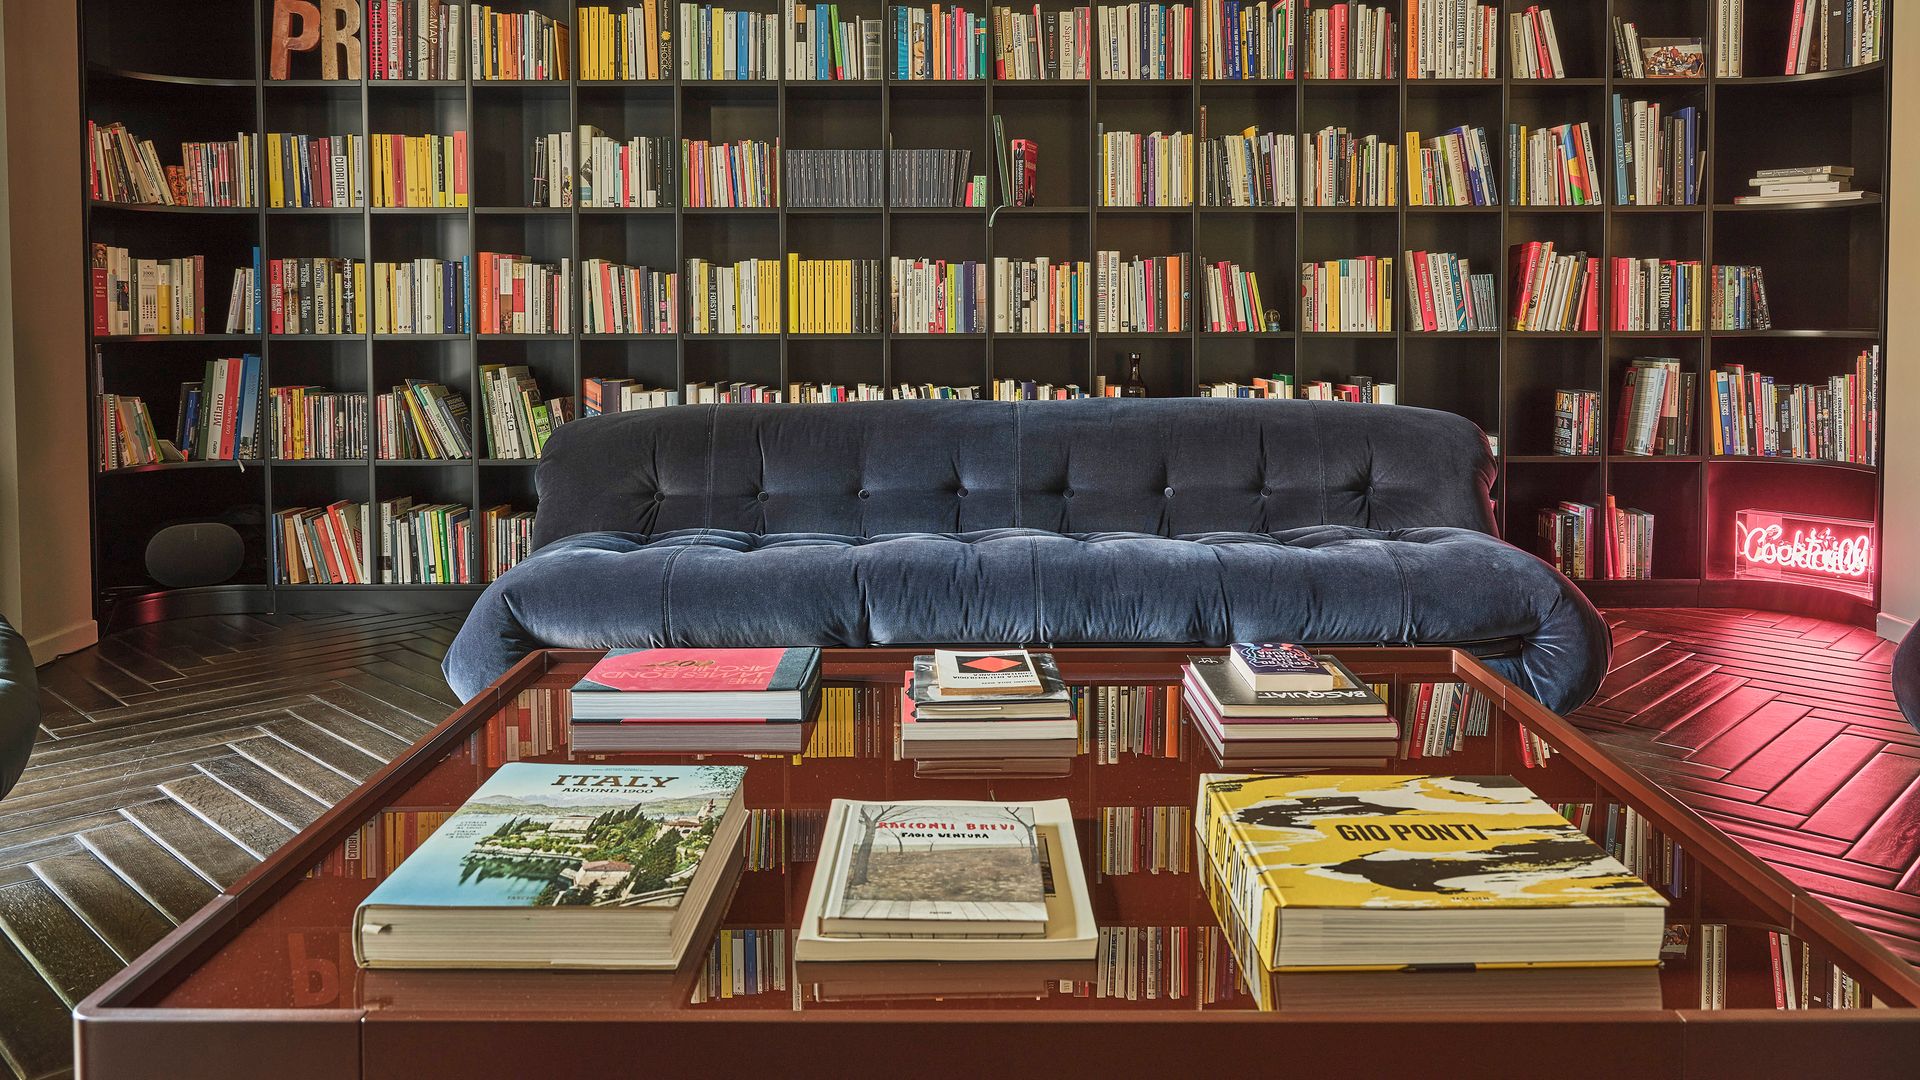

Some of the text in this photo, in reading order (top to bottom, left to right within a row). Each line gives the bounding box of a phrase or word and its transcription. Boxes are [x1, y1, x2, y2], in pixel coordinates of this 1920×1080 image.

[429, 18, 438, 44] MAP
[1457, 0, 1466, 49] SUPERFORECASTING
[1062, 25, 1073, 57] Sapiens
[1453, 146, 1461, 173] FUTURO
[1480, 141, 1489, 167] Languishing
[1617, 145, 1625, 169] JAPAN
[334, 157, 345, 199] CUORI NERI
[1431, 255, 1439, 274] MONEY
[1442, 264, 1453, 296] CHIP WAR
[1455, 281, 1463, 301] CATALYST
[1660, 275, 1671, 308] SPILLOVER
[212, 393, 224, 428] Milano
[600, 671, 772, 679] JAMES BOND
[652, 664, 775, 672] ARCHIVES
[727, 677, 765, 685] THE
[551, 774, 679, 788] ITALY
[879, 822, 1015, 831] RACCONTI BREVI
[1334, 823, 1489, 842] GIO PONTI
[1215, 817, 1227, 871] GIO
